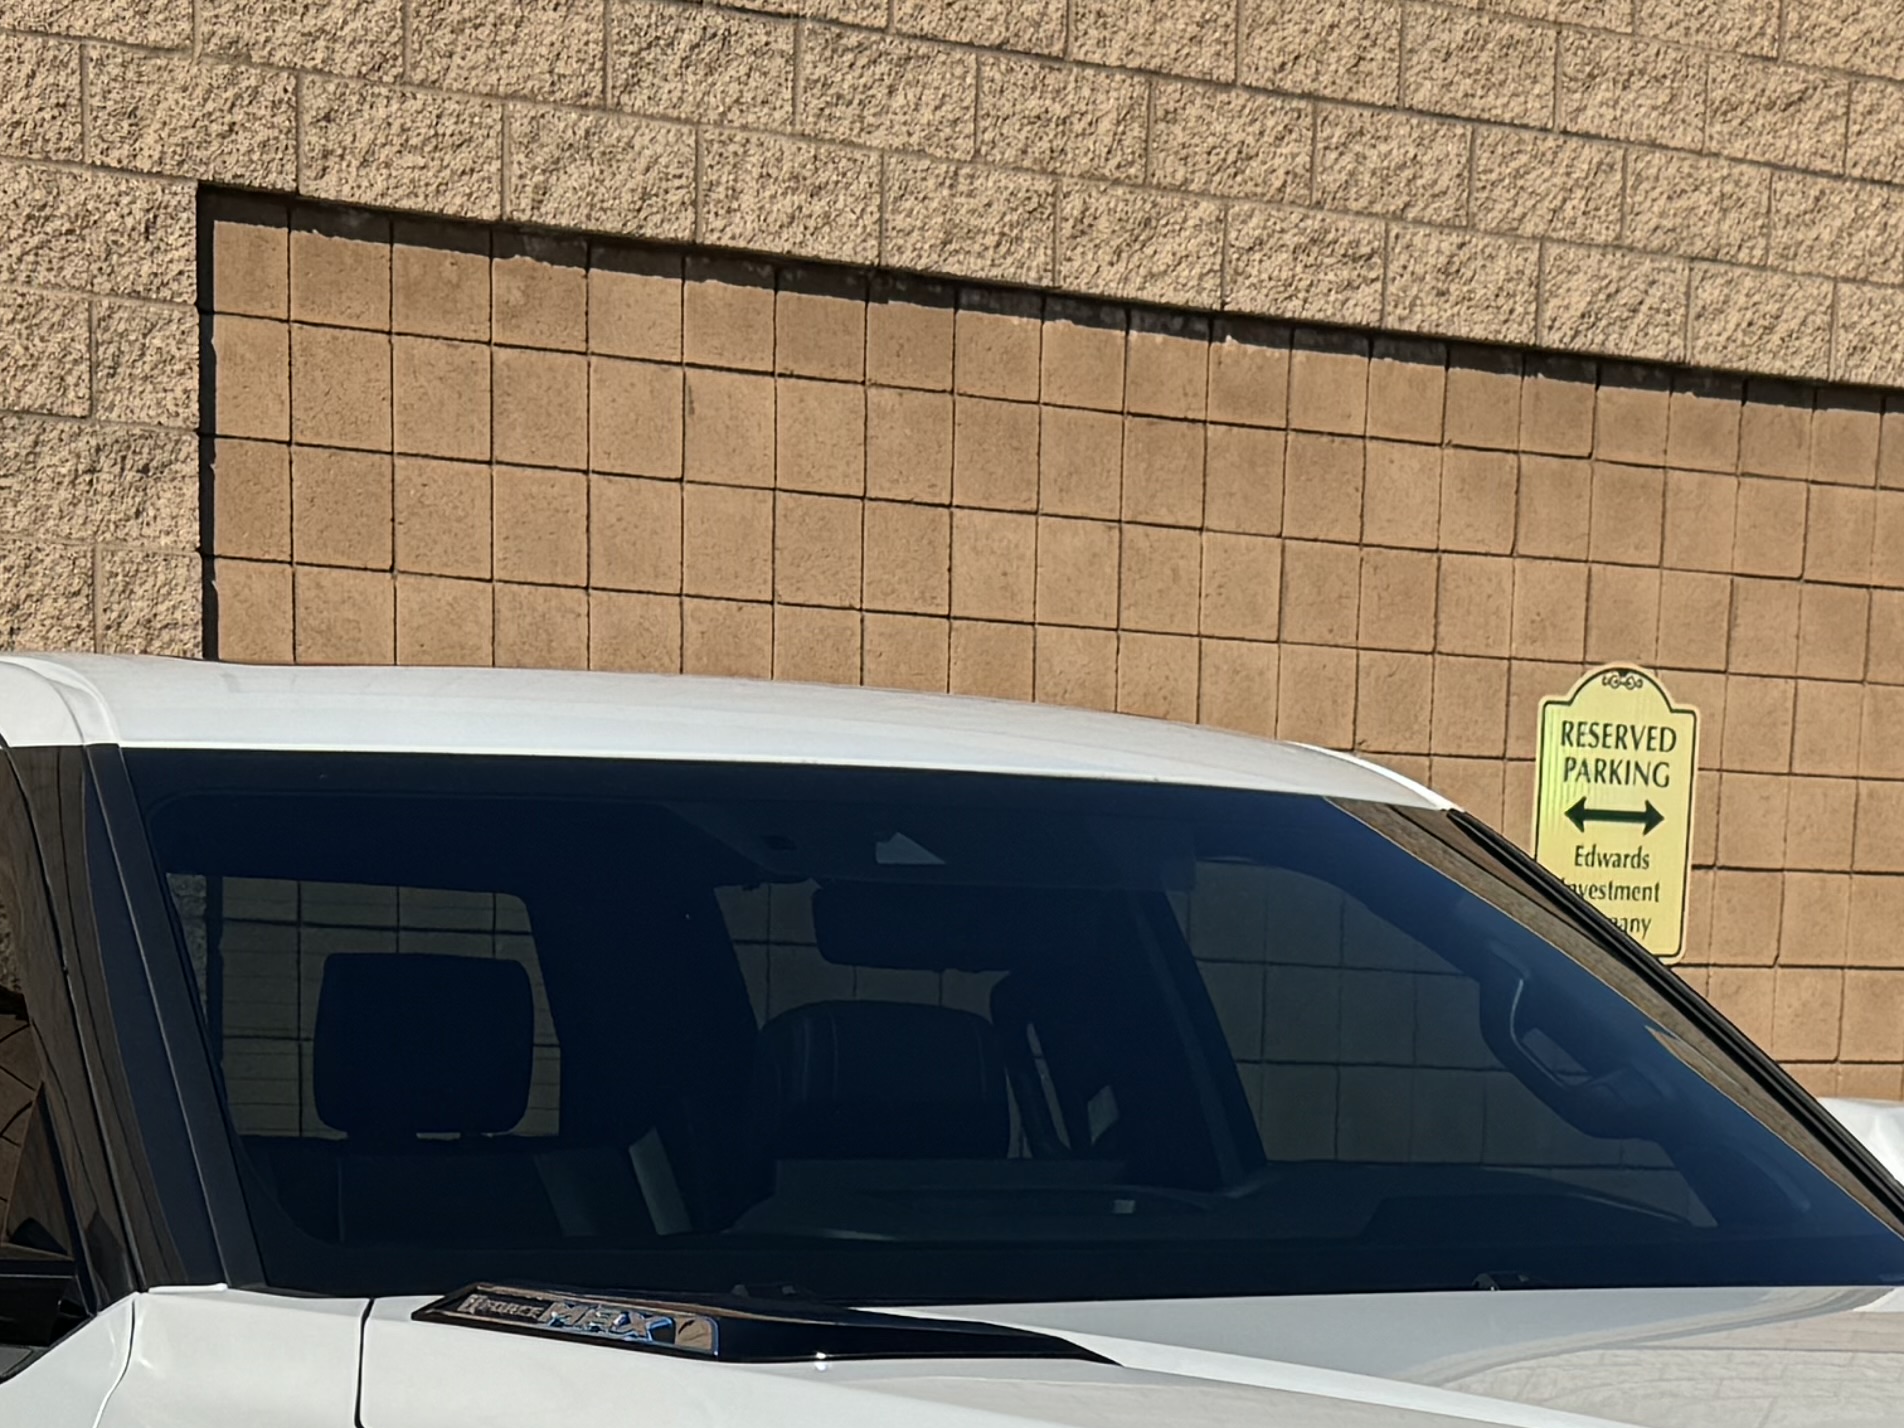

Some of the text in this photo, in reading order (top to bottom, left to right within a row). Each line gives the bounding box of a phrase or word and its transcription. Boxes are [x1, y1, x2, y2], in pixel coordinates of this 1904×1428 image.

[1560, 720, 1677, 752] RESERVED
[1563, 757, 1670, 788] PARKING
[1574, 844, 1650, 870] Edwards
[1560, 877, 1660, 903] nvestment
